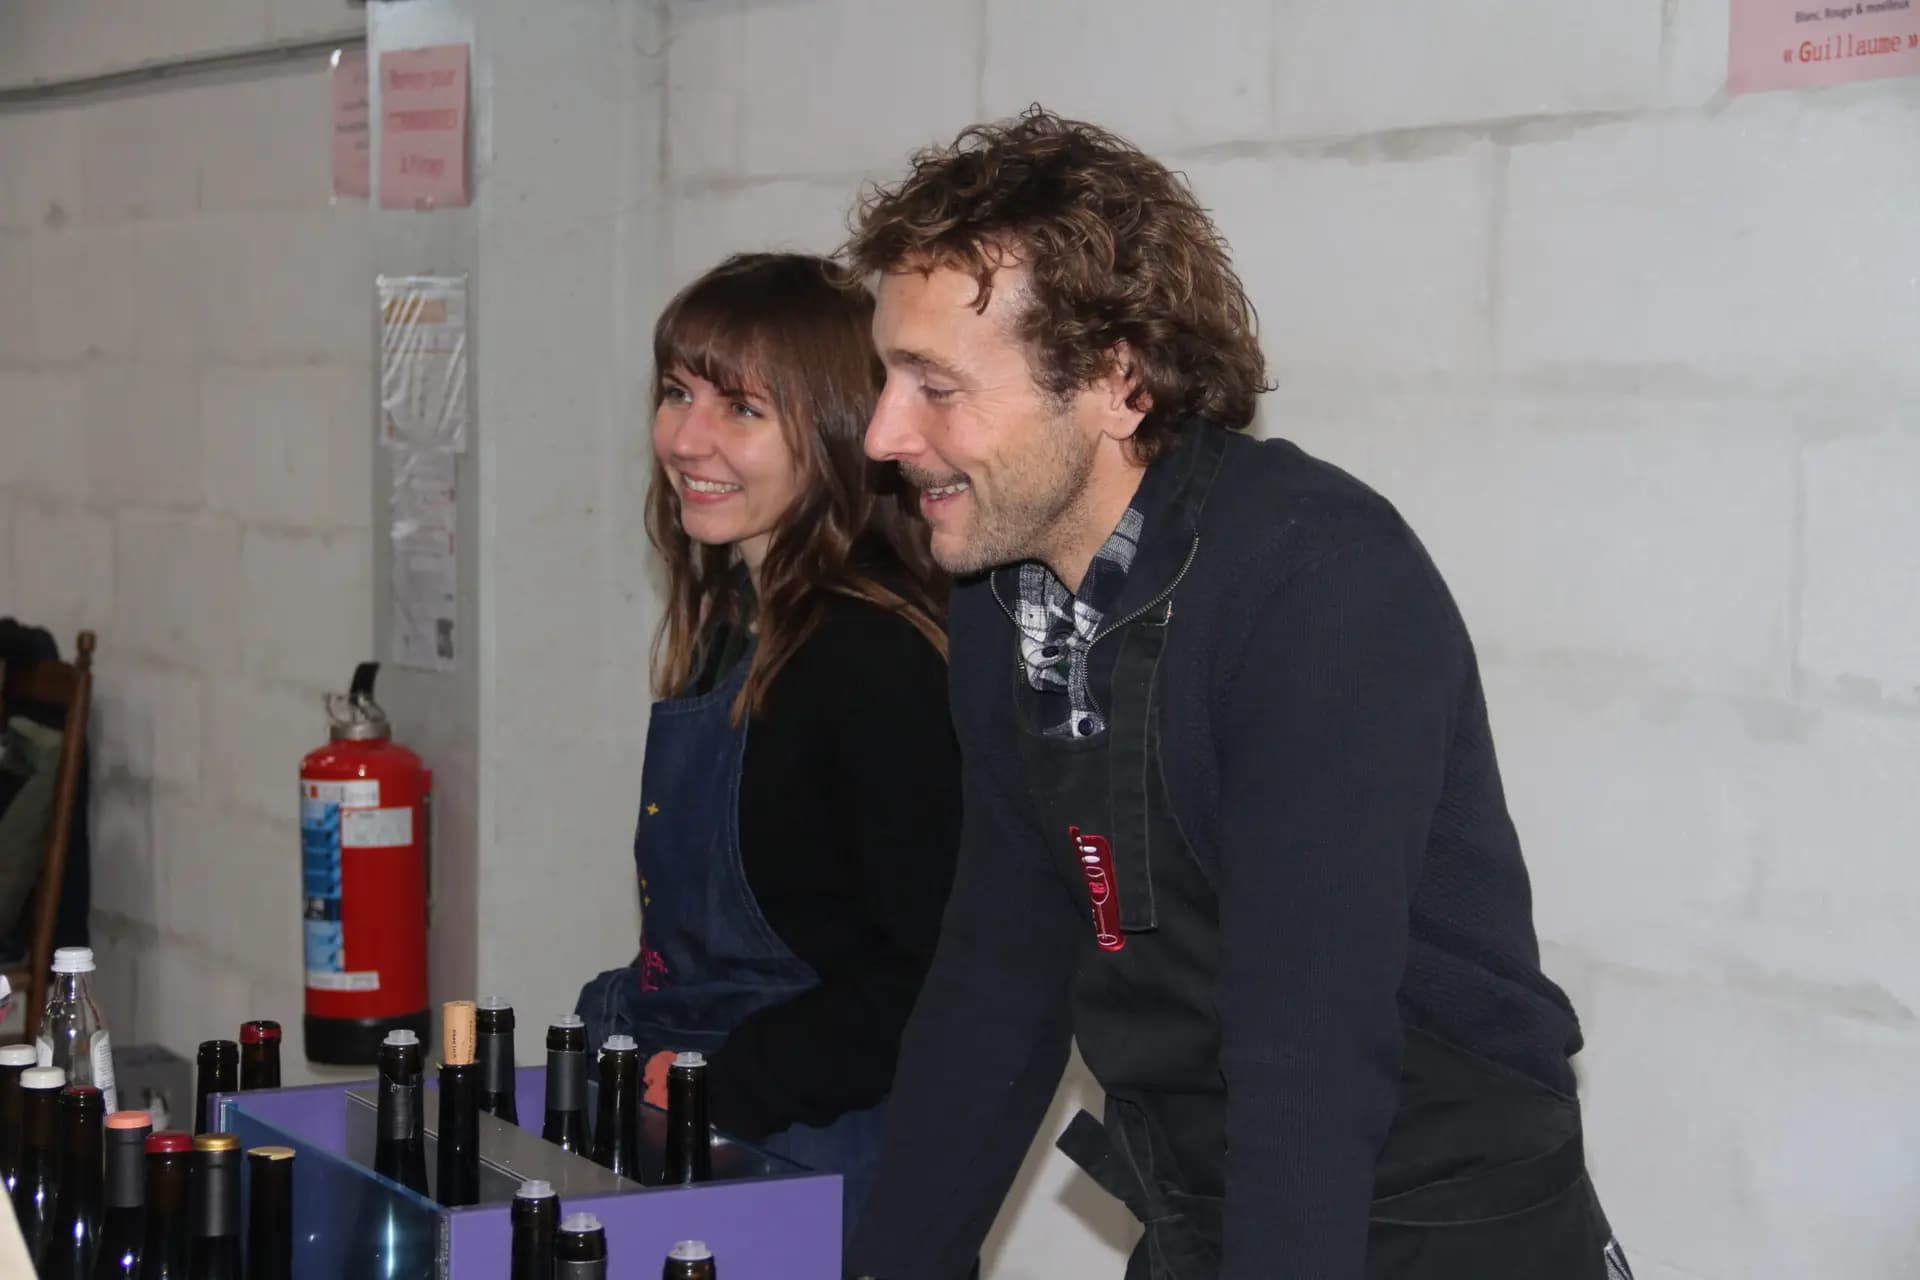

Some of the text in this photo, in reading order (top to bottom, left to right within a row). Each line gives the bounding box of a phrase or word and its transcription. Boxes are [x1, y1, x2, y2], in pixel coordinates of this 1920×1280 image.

[1825, 8, 1853, 19] Rouge
[1856, 3, 1863, 14] &
[1798, 32, 1902, 63] Guillaume
